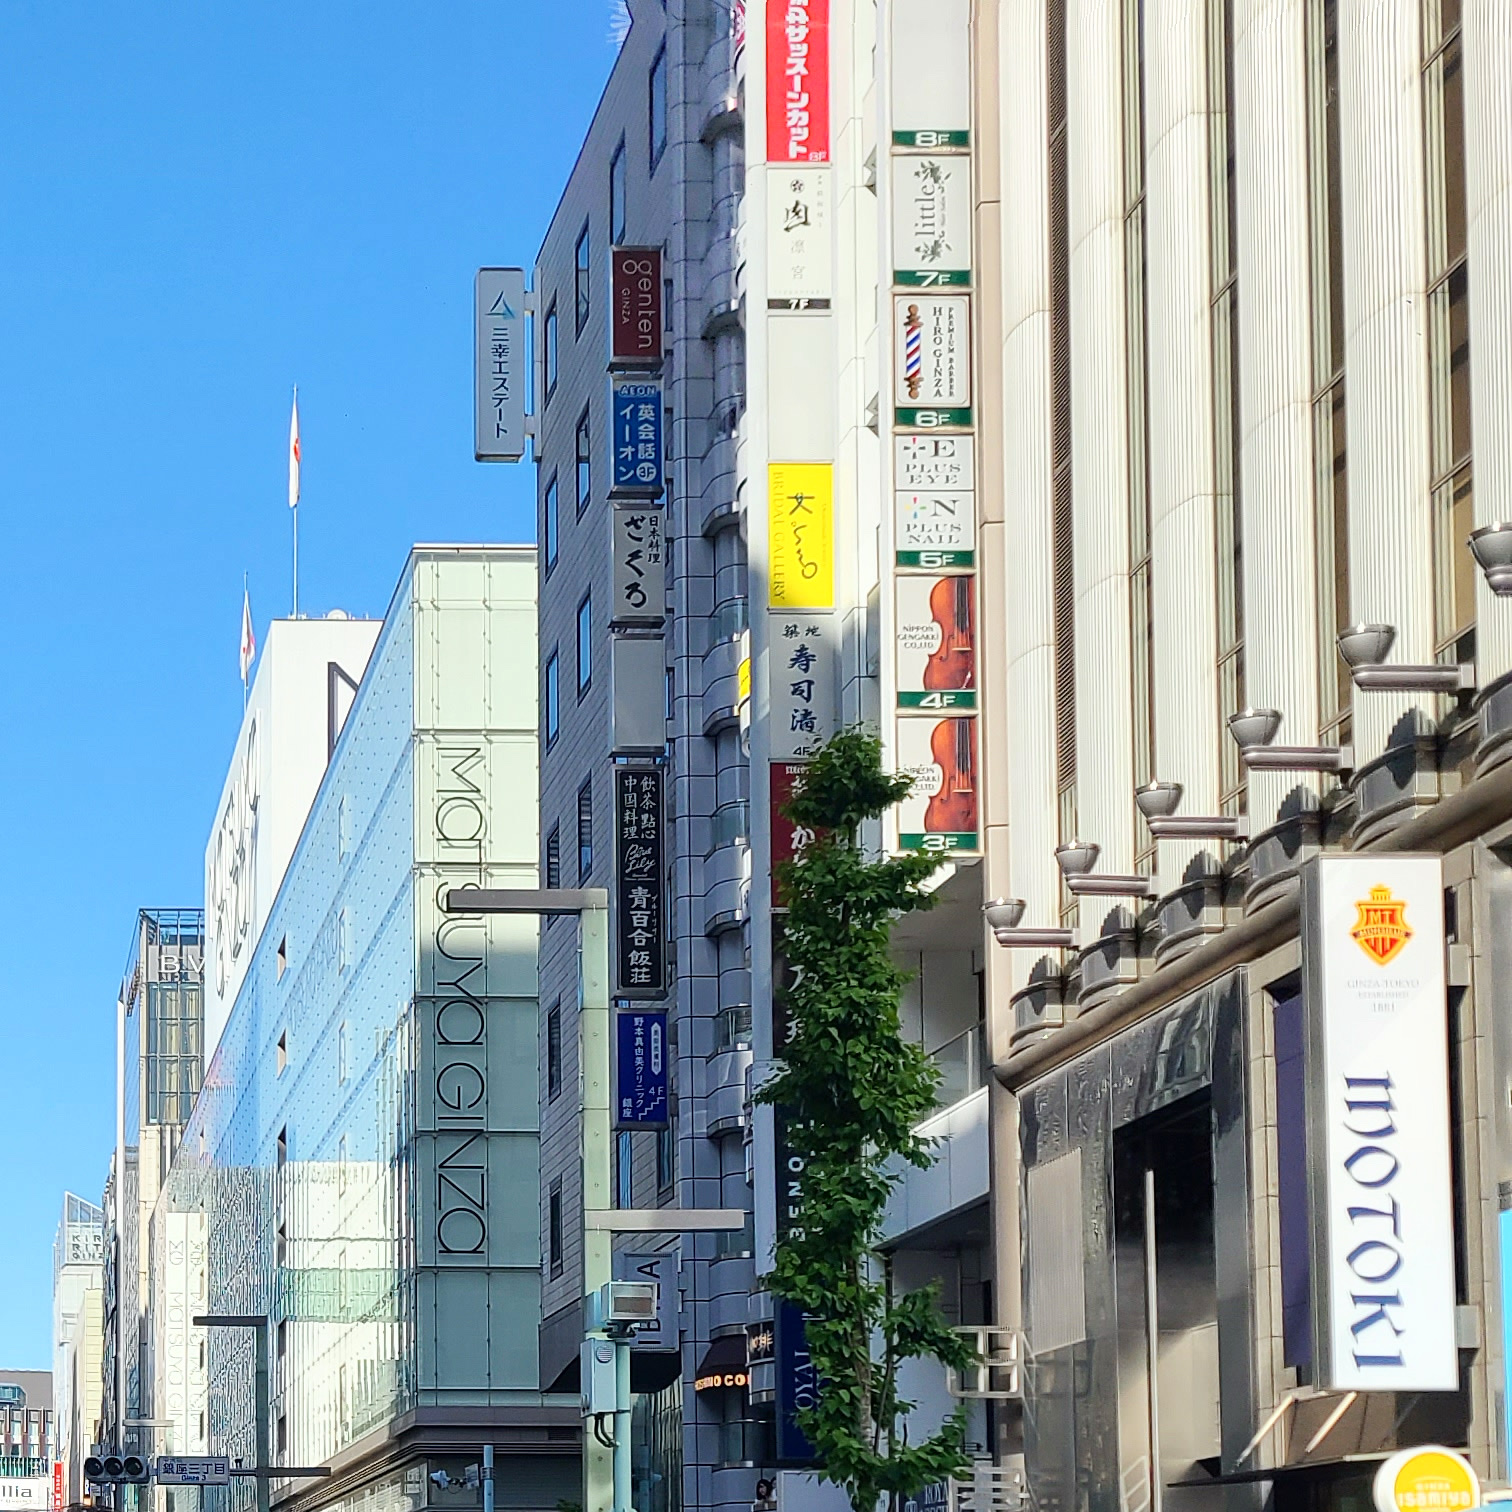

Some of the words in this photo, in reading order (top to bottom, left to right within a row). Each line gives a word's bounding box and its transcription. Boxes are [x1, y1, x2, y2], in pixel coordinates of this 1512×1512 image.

[915, 132, 950, 146] 8F
[915, 184, 935, 235] little
[915, 271, 951, 287] 7F
[622, 288, 631, 324] GINZA
[623, 260, 656, 348] genten
[789, 299, 809, 310] 7F
[933, 307, 943, 345] HIRO
[933, 349, 943, 397] GINZA
[491, 328, 509, 438] 三幸エステート
[619, 386, 656, 395] AEON
[915, 411, 950, 427] 6F
[638, 405, 656, 459] 英会話
[619, 404, 635, 481] イーオン
[638, 465, 655, 479] 3F
[906, 464, 961, 473] PLUS
[910, 475, 958, 484] EYE
[773, 472, 784, 523] BRIDAL
[930, 500, 959, 516] N
[906, 524, 962, 532] PLUS
[648, 516, 660, 563] 日本料理
[908, 535, 960, 543] NAIL
[624, 515, 646, 608] ざくろ
[773, 532, 785, 600] GALLERY
[920, 552, 955, 567] 5F
[919, 693, 956, 708] 4F
[623, 776, 638, 839] 中国料理
[922, 835, 957, 850] 3F
[627, 886, 653, 984] 青百合飯荘
[648, 1086, 664, 1096] 4F
[163, 1463, 225, 1474] 銀座三丁目
